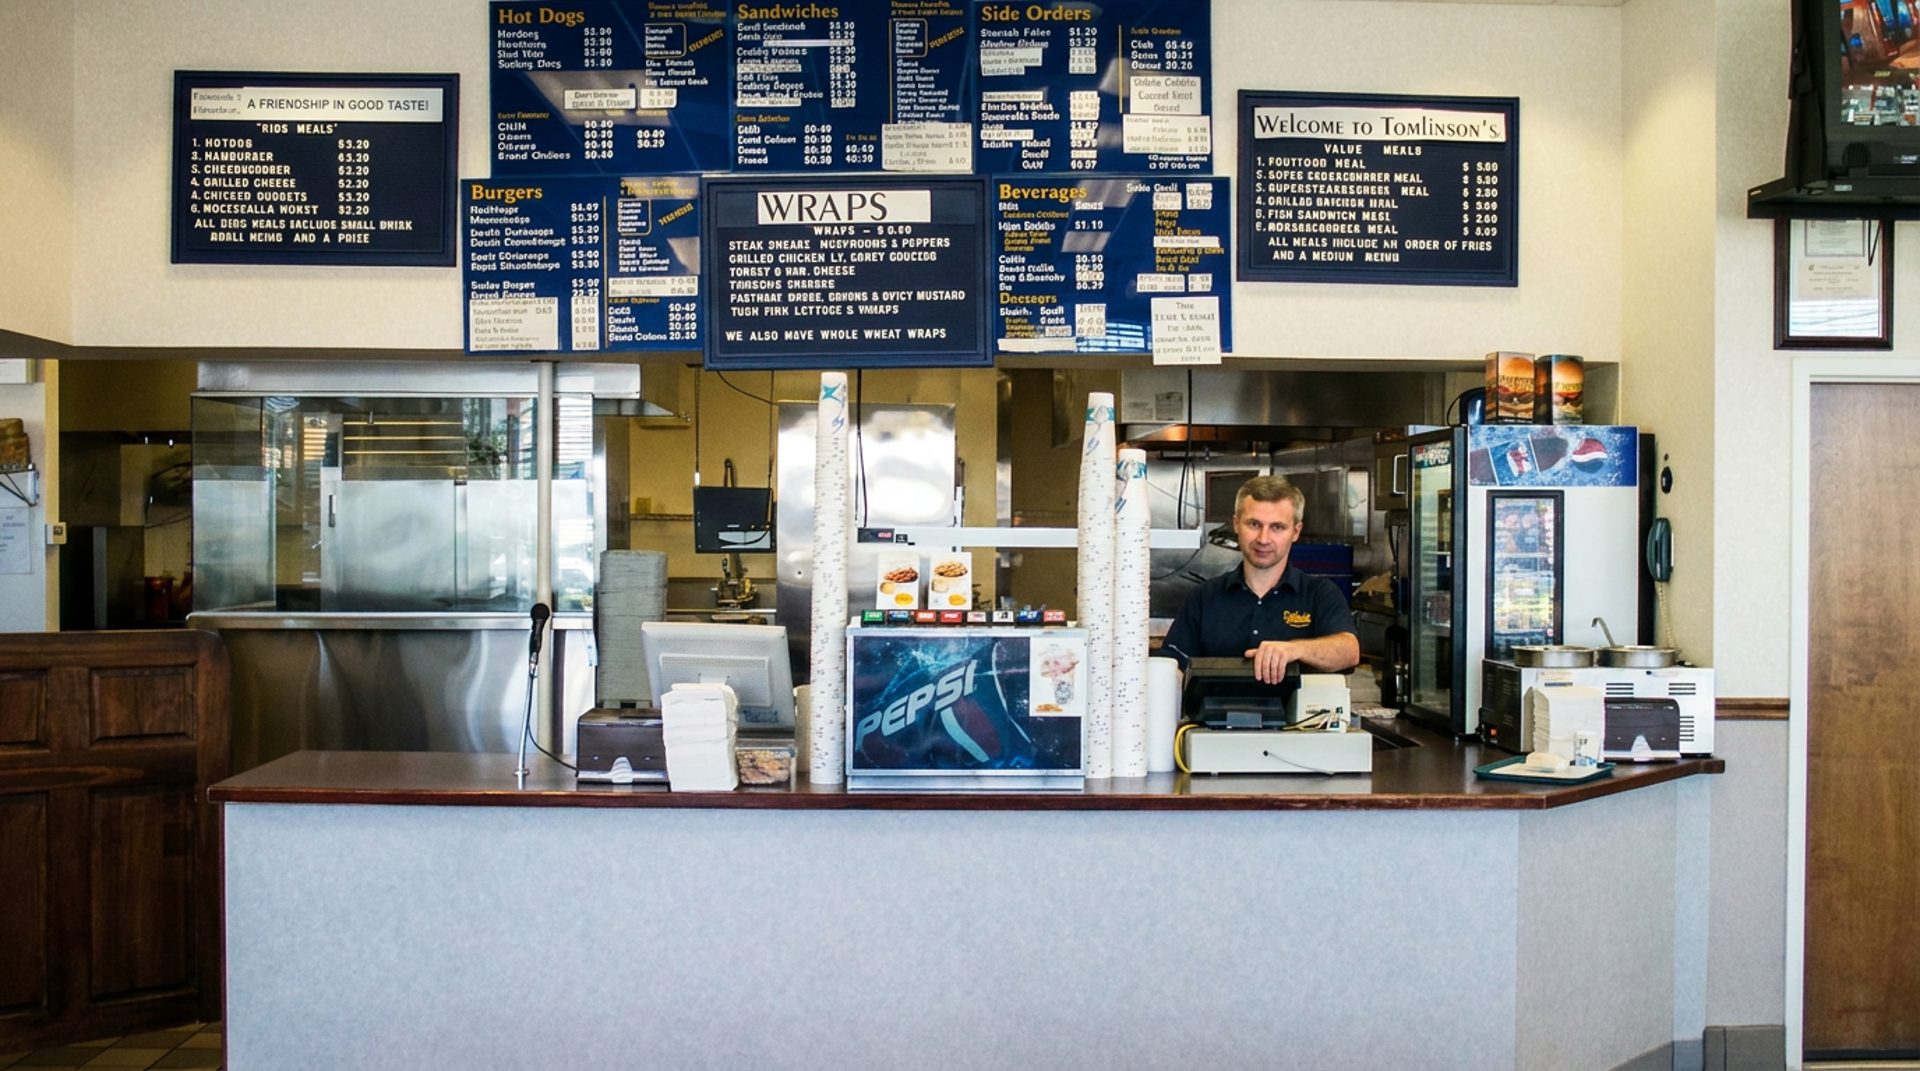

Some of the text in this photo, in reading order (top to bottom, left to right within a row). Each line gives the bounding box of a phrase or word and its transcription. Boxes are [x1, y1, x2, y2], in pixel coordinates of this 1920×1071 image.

[498, 8, 585, 27] Hot Dogs
[737, 4, 839, 20] Sandwiches
[981, 5, 1020, 22] Side
[1026, 4, 1092, 21] Orders
[247, 99, 429, 111] A FRIENDSHIP IN GOOD TASTE!
[1324, 144, 1362, 154] VALUE
[471, 184, 543, 204] Burgers
[999, 184, 1087, 202] Beverages
[761, 192, 888, 222] WRAPS
[194, 219, 215, 228] ALL
[729, 241, 764, 250] STEAK
[1268, 238, 1289, 247] ALL
[1444, 240, 1458, 250] OF
[729, 253, 774, 264] GRILLED
[1299, 251, 1307, 260] A
[725, 331, 743, 341] WE
[750, 331, 778, 341] ALSO
[907, 328, 947, 339] WRAPS
[855, 659, 979, 751] PEPSI
